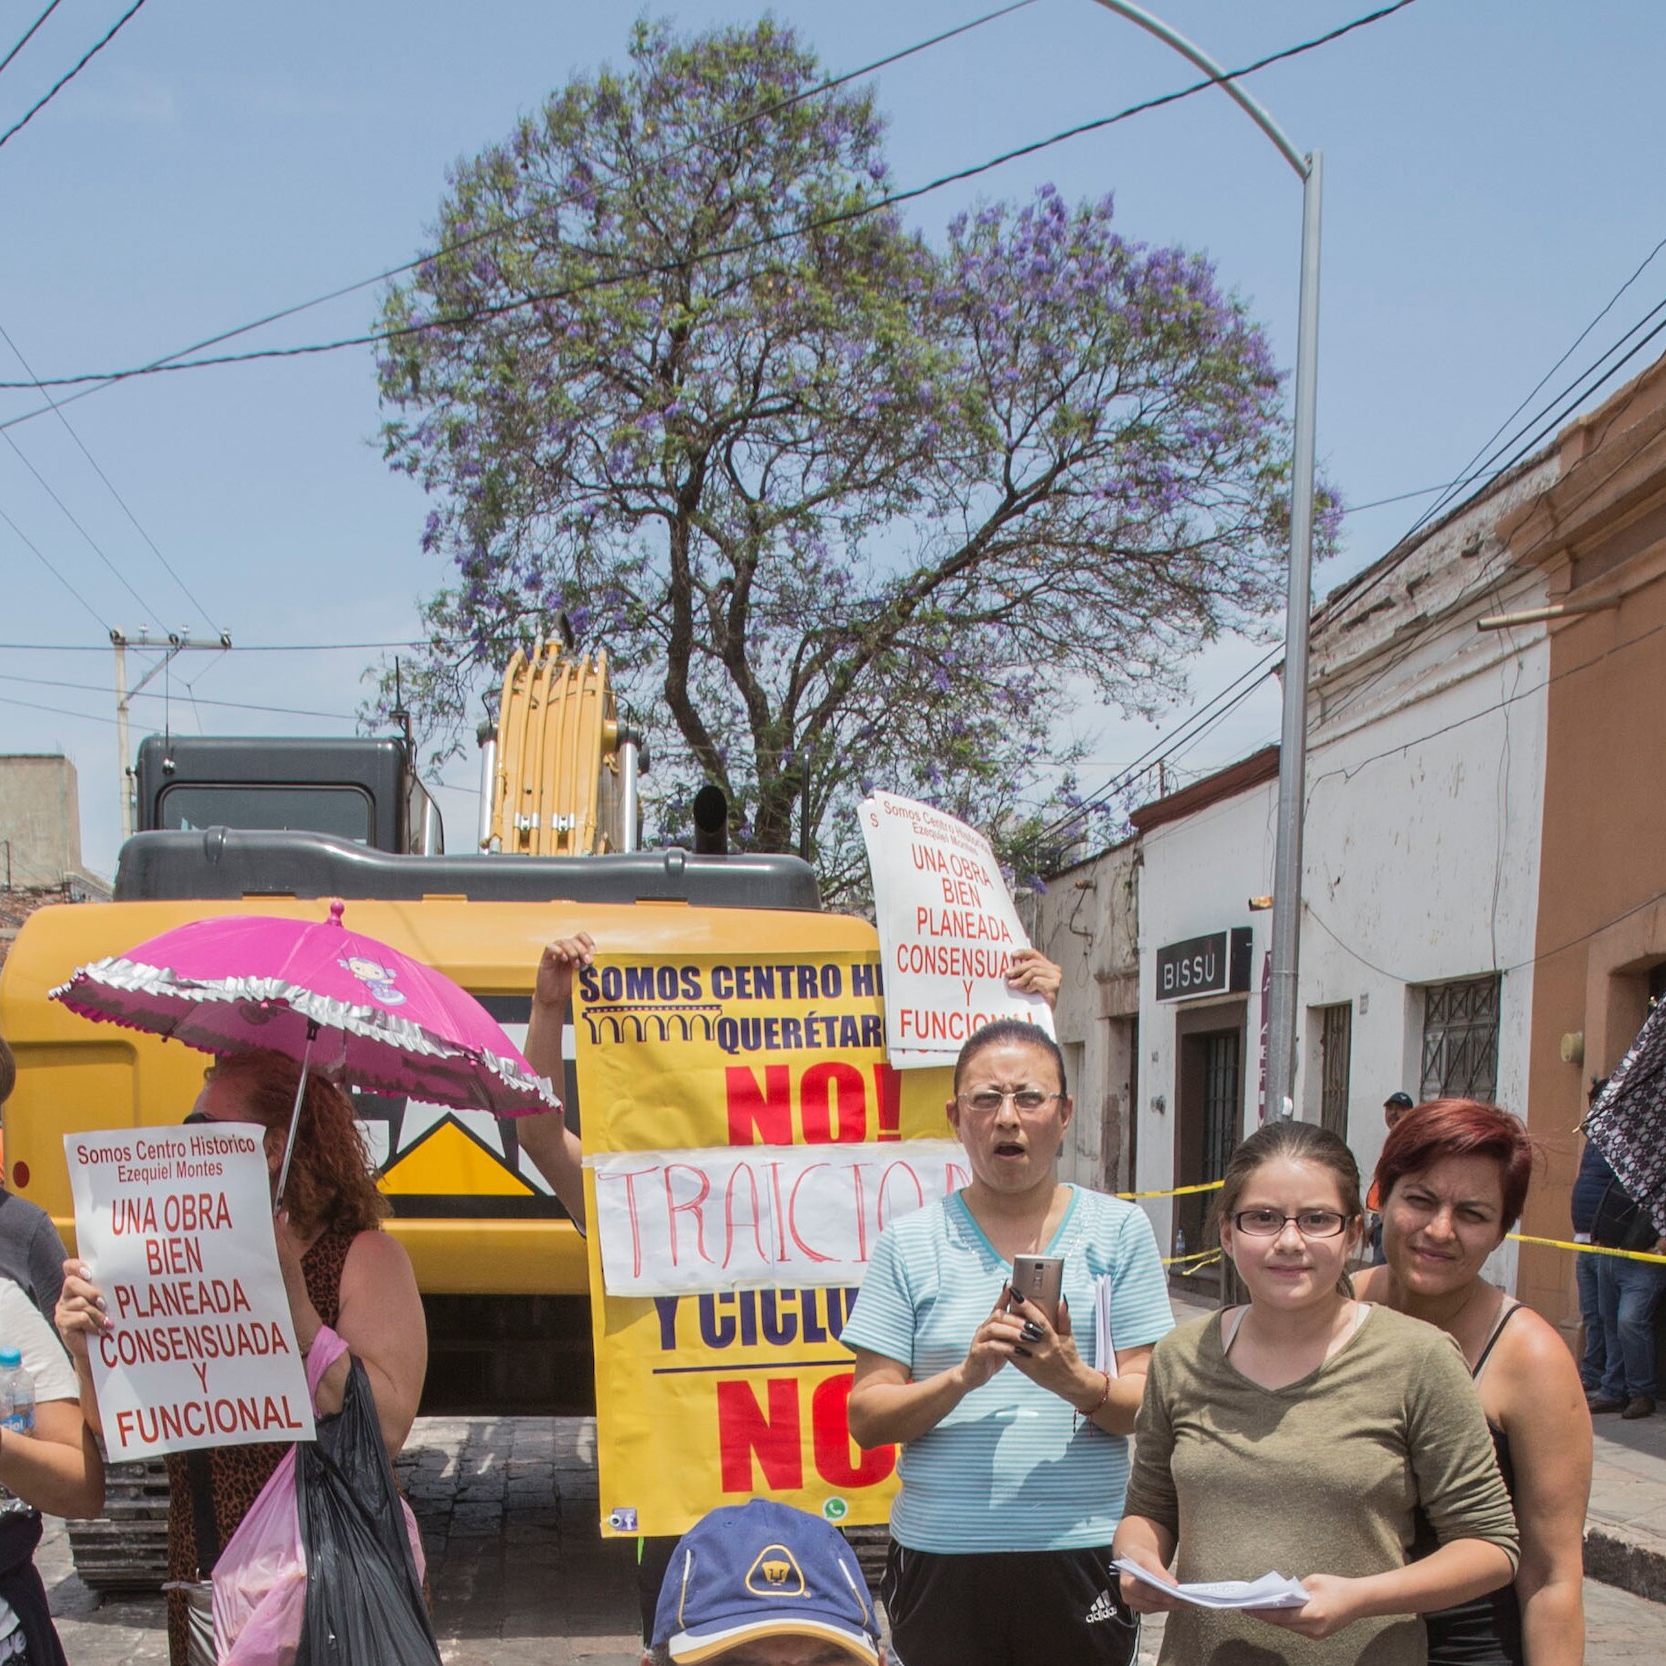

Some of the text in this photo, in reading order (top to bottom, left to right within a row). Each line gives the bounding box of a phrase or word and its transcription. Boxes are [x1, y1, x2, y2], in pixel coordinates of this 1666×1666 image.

[884, 800, 921, 822] Somos
[912, 843, 949, 874] UNA
[950, 853, 994, 890] OBRA
[942, 878, 982, 909] BIEN
[917, 906, 1013, 944] PLANEADA
[897, 943, 1025, 980] CONSENSUA
[579, 966, 703, 1003] SOMOS
[713, 964, 844, 1001] CENTRO
[962, 980, 974, 1007] Y
[717, 1010, 886, 1053] QUERÉTAR
[725, 1062, 902, 1147] NO!
[77, 1134, 256, 1166] Somos Centro Historico
[117, 1161, 223, 1186] Ezequiel Montes
[111, 1192, 233, 1237] UNA OBRA
[146, 1236, 204, 1277] BIEN
[115, 1278, 252, 1320] PLANEADA
[653, 1295, 680, 1351] Y
[99, 1321, 289, 1369] CONSENSUADA
[193, 1362, 208, 1395] Y
[115, 1395, 303, 1448] FUNCIONAL
[717, 1374, 899, 1494] NO
